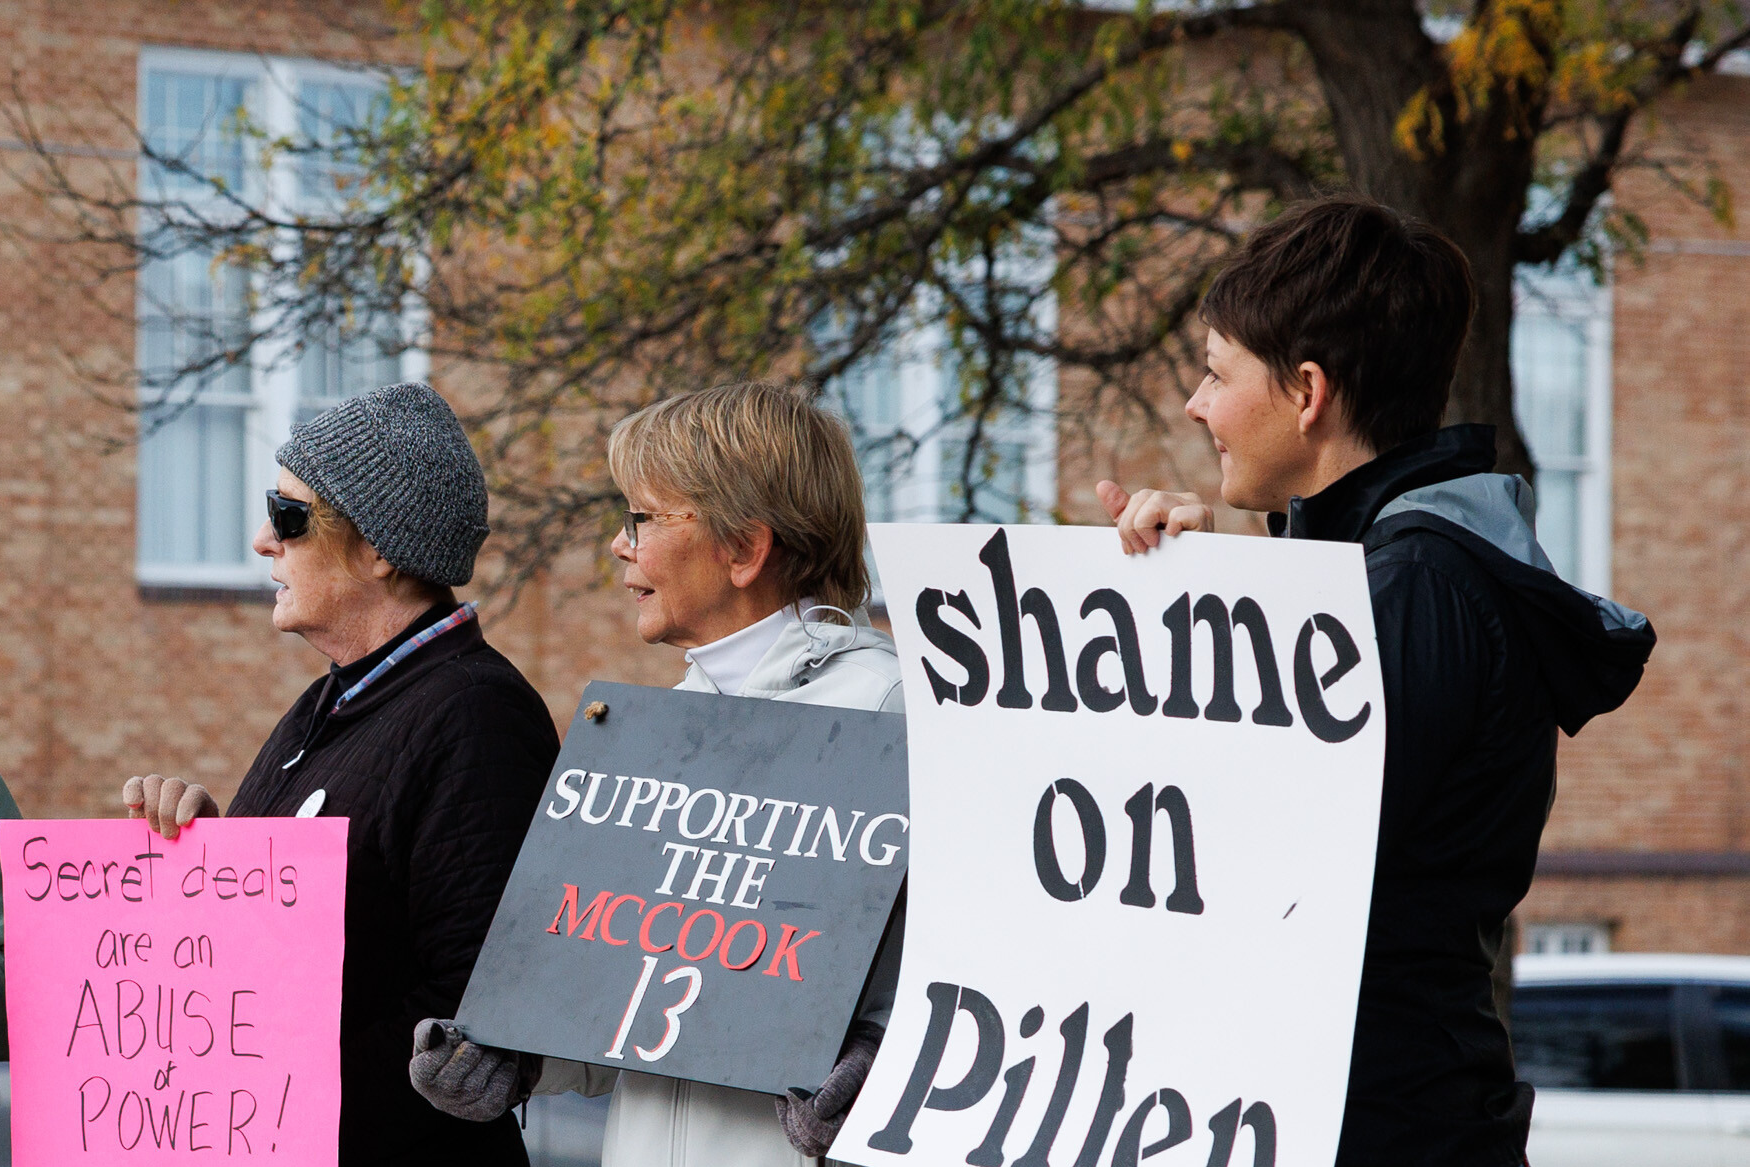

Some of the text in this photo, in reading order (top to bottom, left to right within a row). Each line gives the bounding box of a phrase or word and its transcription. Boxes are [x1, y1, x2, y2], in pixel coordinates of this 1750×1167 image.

[915, 527, 1371, 743] shame
[546, 768, 910, 866] SUPPORTING
[1033, 777, 1206, 914] on
[22, 831, 298, 907] Secret deals
[654, 842, 776, 910] THE
[96, 929, 214, 968] are an
[545, 883, 822, 981] MCCOOK
[66, 978, 264, 1060] ABUSE
[604, 955, 703, 1062] 13
[78, 1073, 291, 1156] POWER!
[154, 1060, 178, 1091] of
